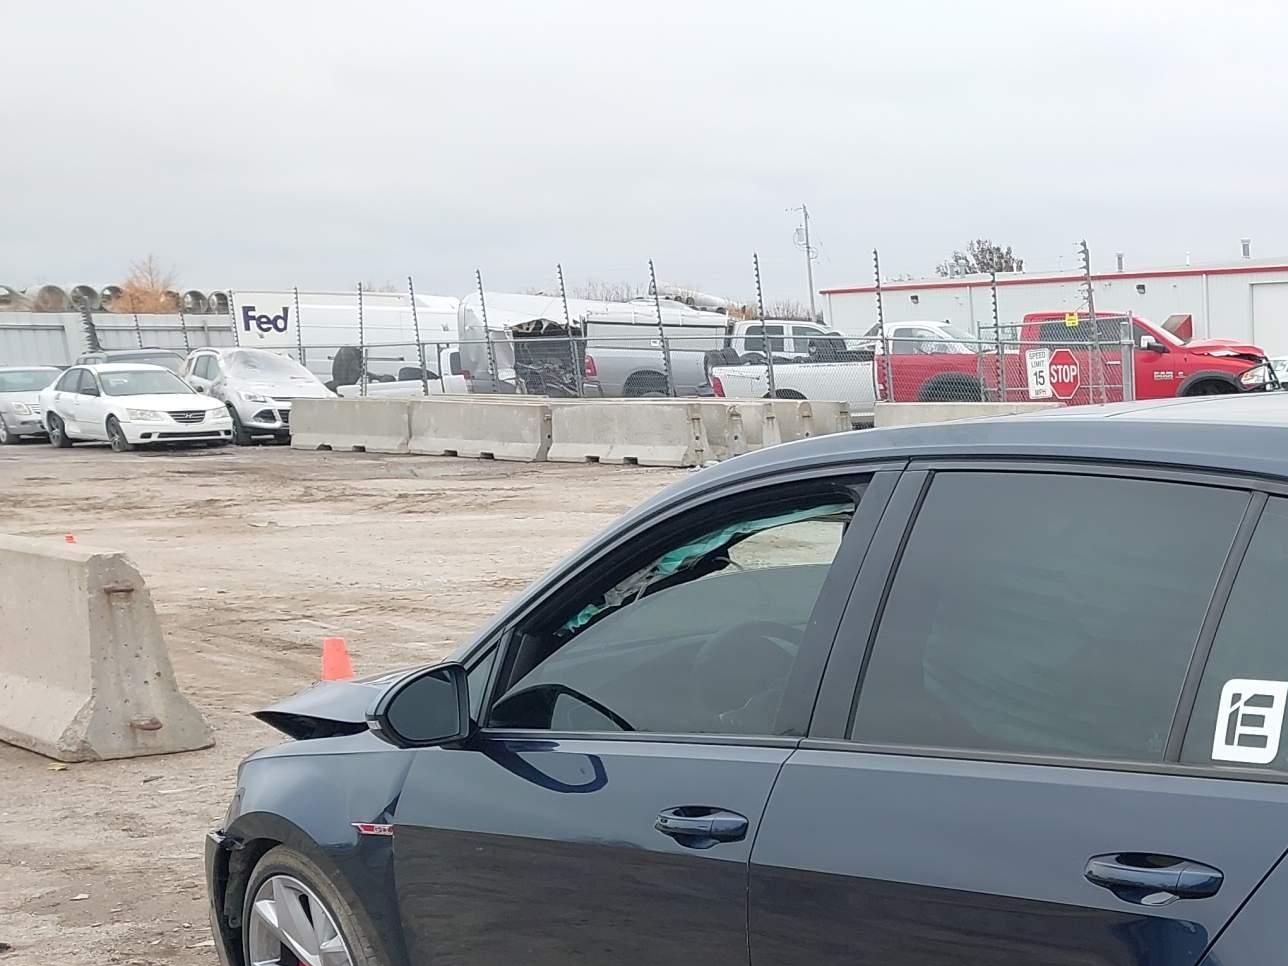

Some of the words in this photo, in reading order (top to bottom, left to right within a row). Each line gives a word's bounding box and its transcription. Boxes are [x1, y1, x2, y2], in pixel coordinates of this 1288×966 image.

[242, 306, 289, 332] Fed
[1028, 351, 1046, 360] SPEED
[1030, 359, 1045, 368] LIMIT
[1033, 370, 1046, 386] 15
[1050, 364, 1077, 383] STOP
